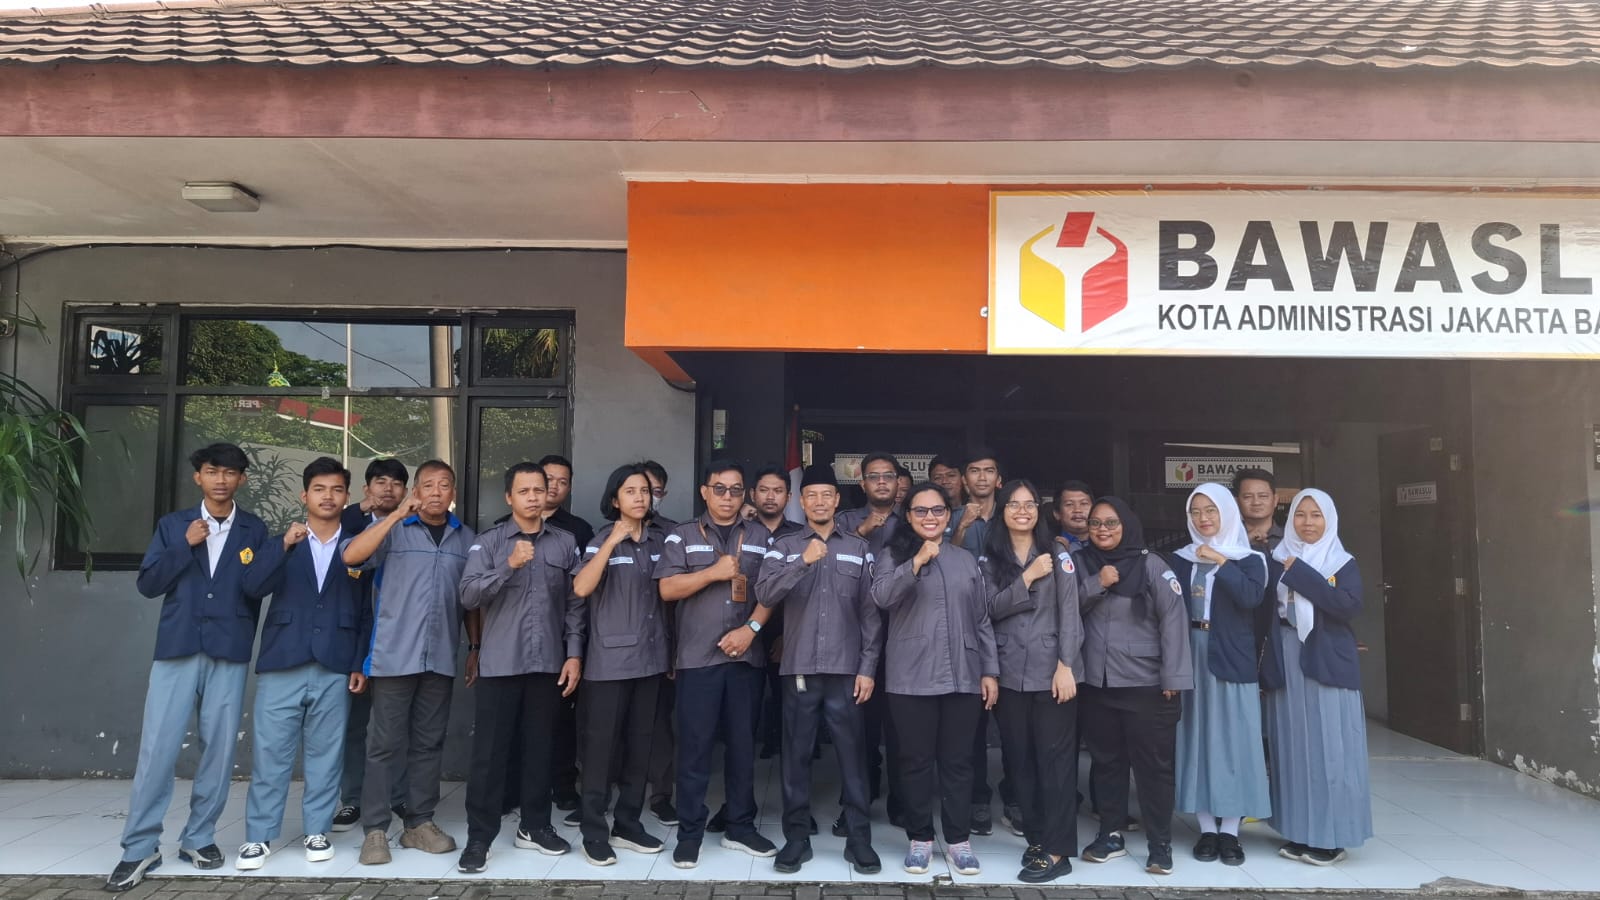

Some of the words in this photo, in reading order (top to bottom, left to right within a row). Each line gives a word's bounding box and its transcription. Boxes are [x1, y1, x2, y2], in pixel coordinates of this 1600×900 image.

[1158, 220, 1593, 296] BAWASL
[1158, 304, 1232, 331] KOTA
[1237, 304, 1432, 333] ADMINISTRASI
[1441, 306, 1568, 334] JAKARTA
